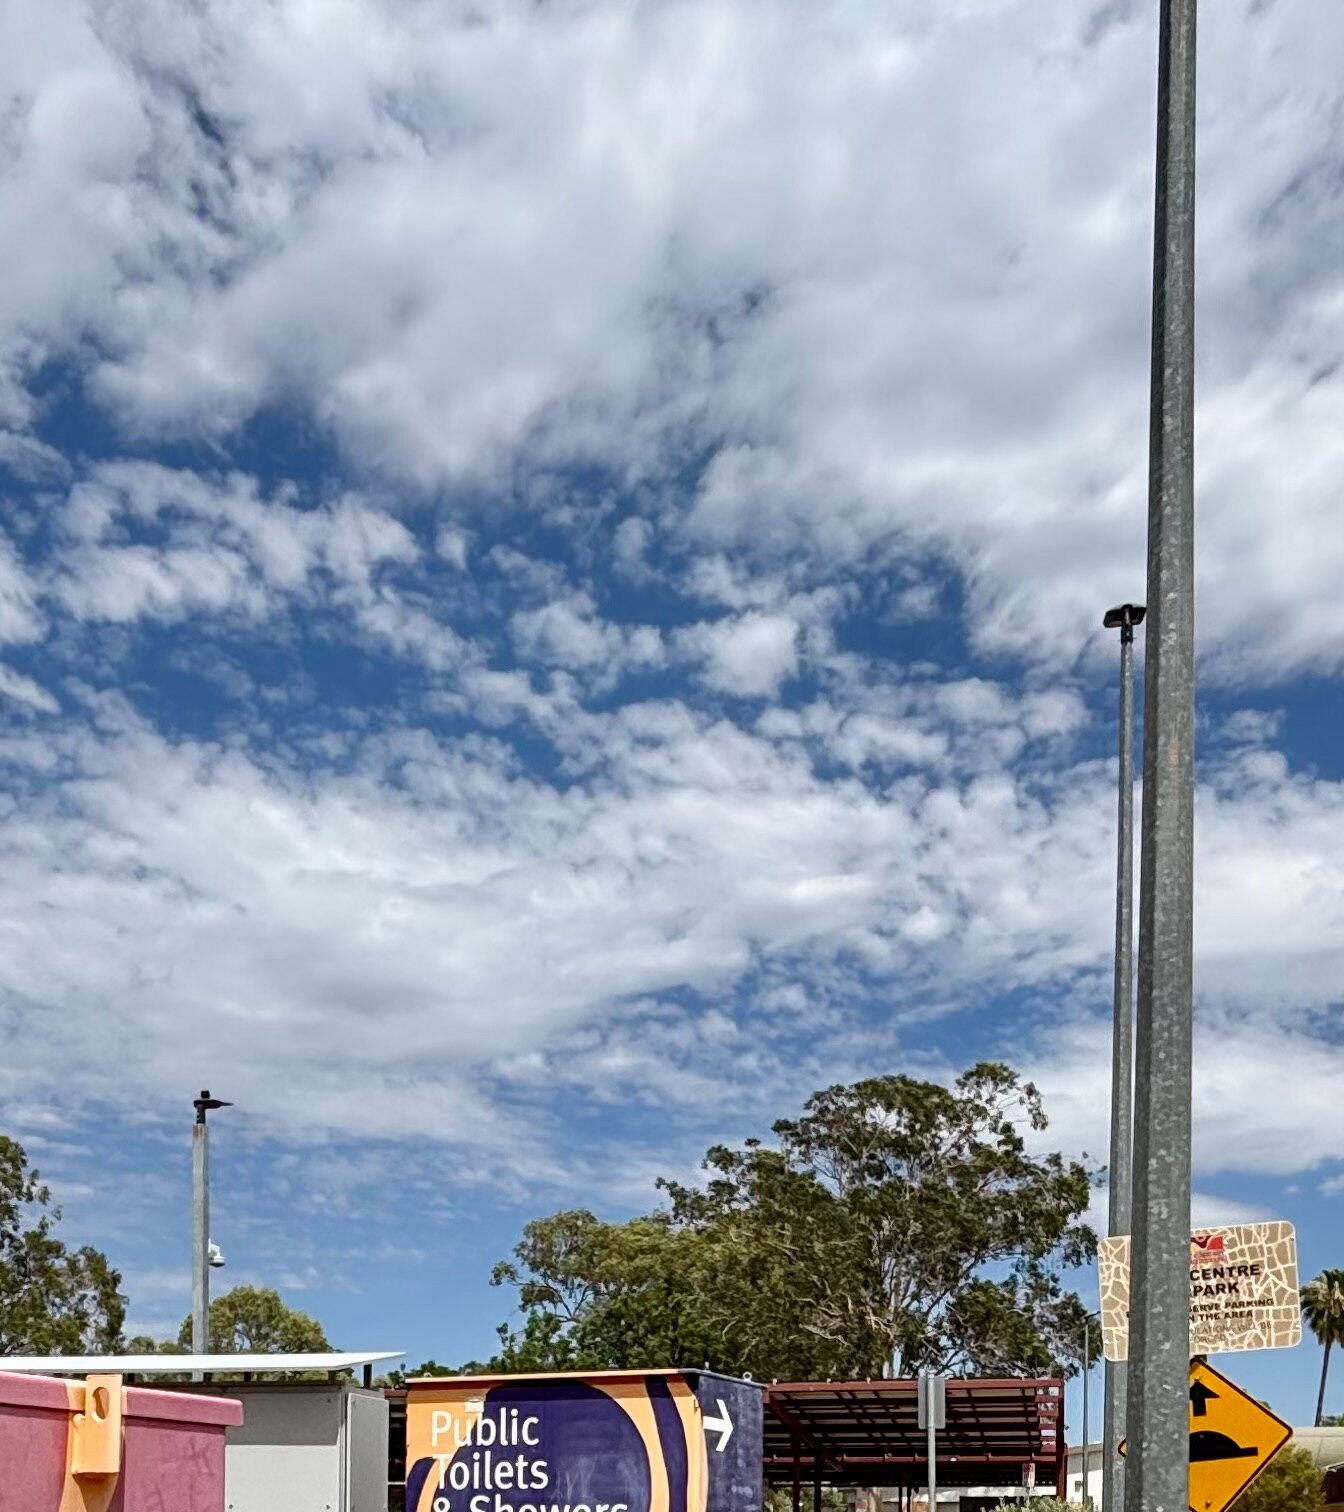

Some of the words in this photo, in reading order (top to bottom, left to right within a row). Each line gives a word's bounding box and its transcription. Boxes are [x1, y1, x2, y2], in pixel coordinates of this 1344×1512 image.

[1190, 1264, 1261, 1281] CENTRE
[1224, 1299, 1274, 1309] PARKING
[1224, 1310, 1253, 1319] AREA
[431, 1407, 540, 1447] Public
[432, 1450, 549, 1490] Toilets
